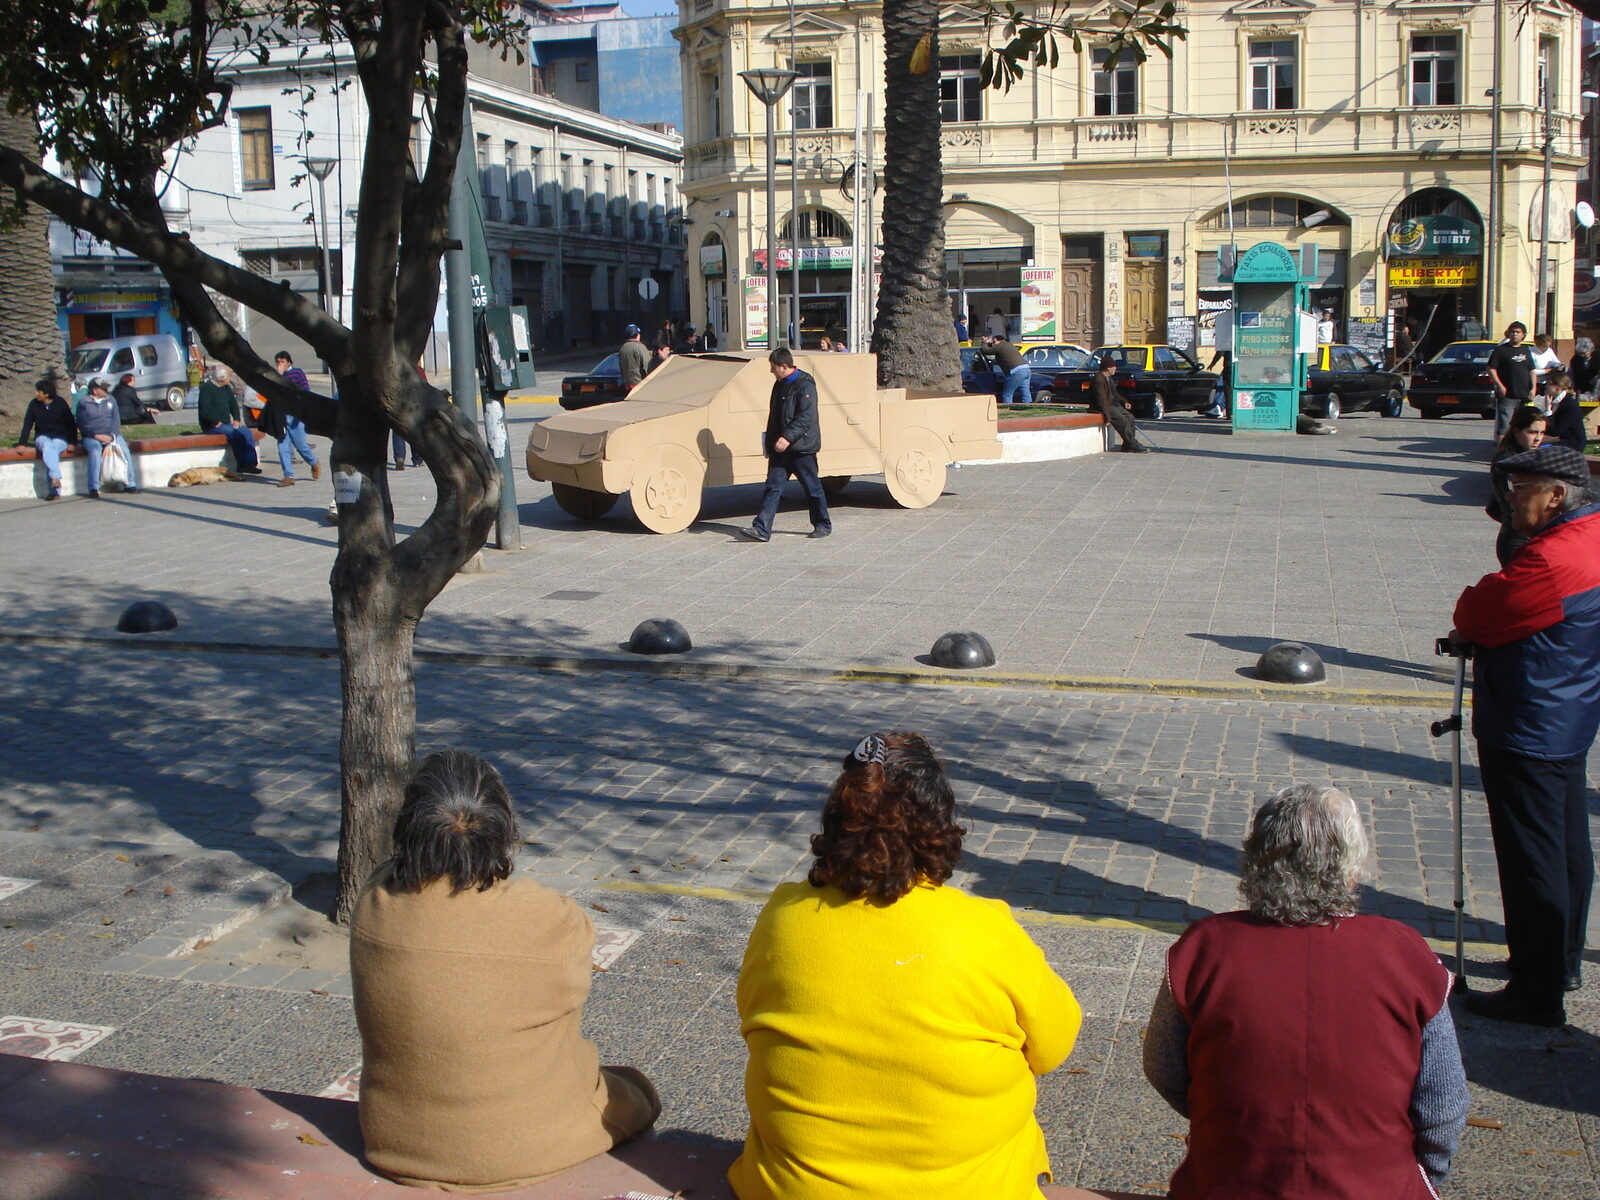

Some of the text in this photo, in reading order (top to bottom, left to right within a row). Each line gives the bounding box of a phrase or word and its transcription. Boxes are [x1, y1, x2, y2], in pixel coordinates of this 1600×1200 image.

[1432, 236, 1471, 244] LIBERTY
[1240, 244, 1294, 272] TAXIS ECHAURREN
[1198, 298, 1232, 310] EMPANADAS
